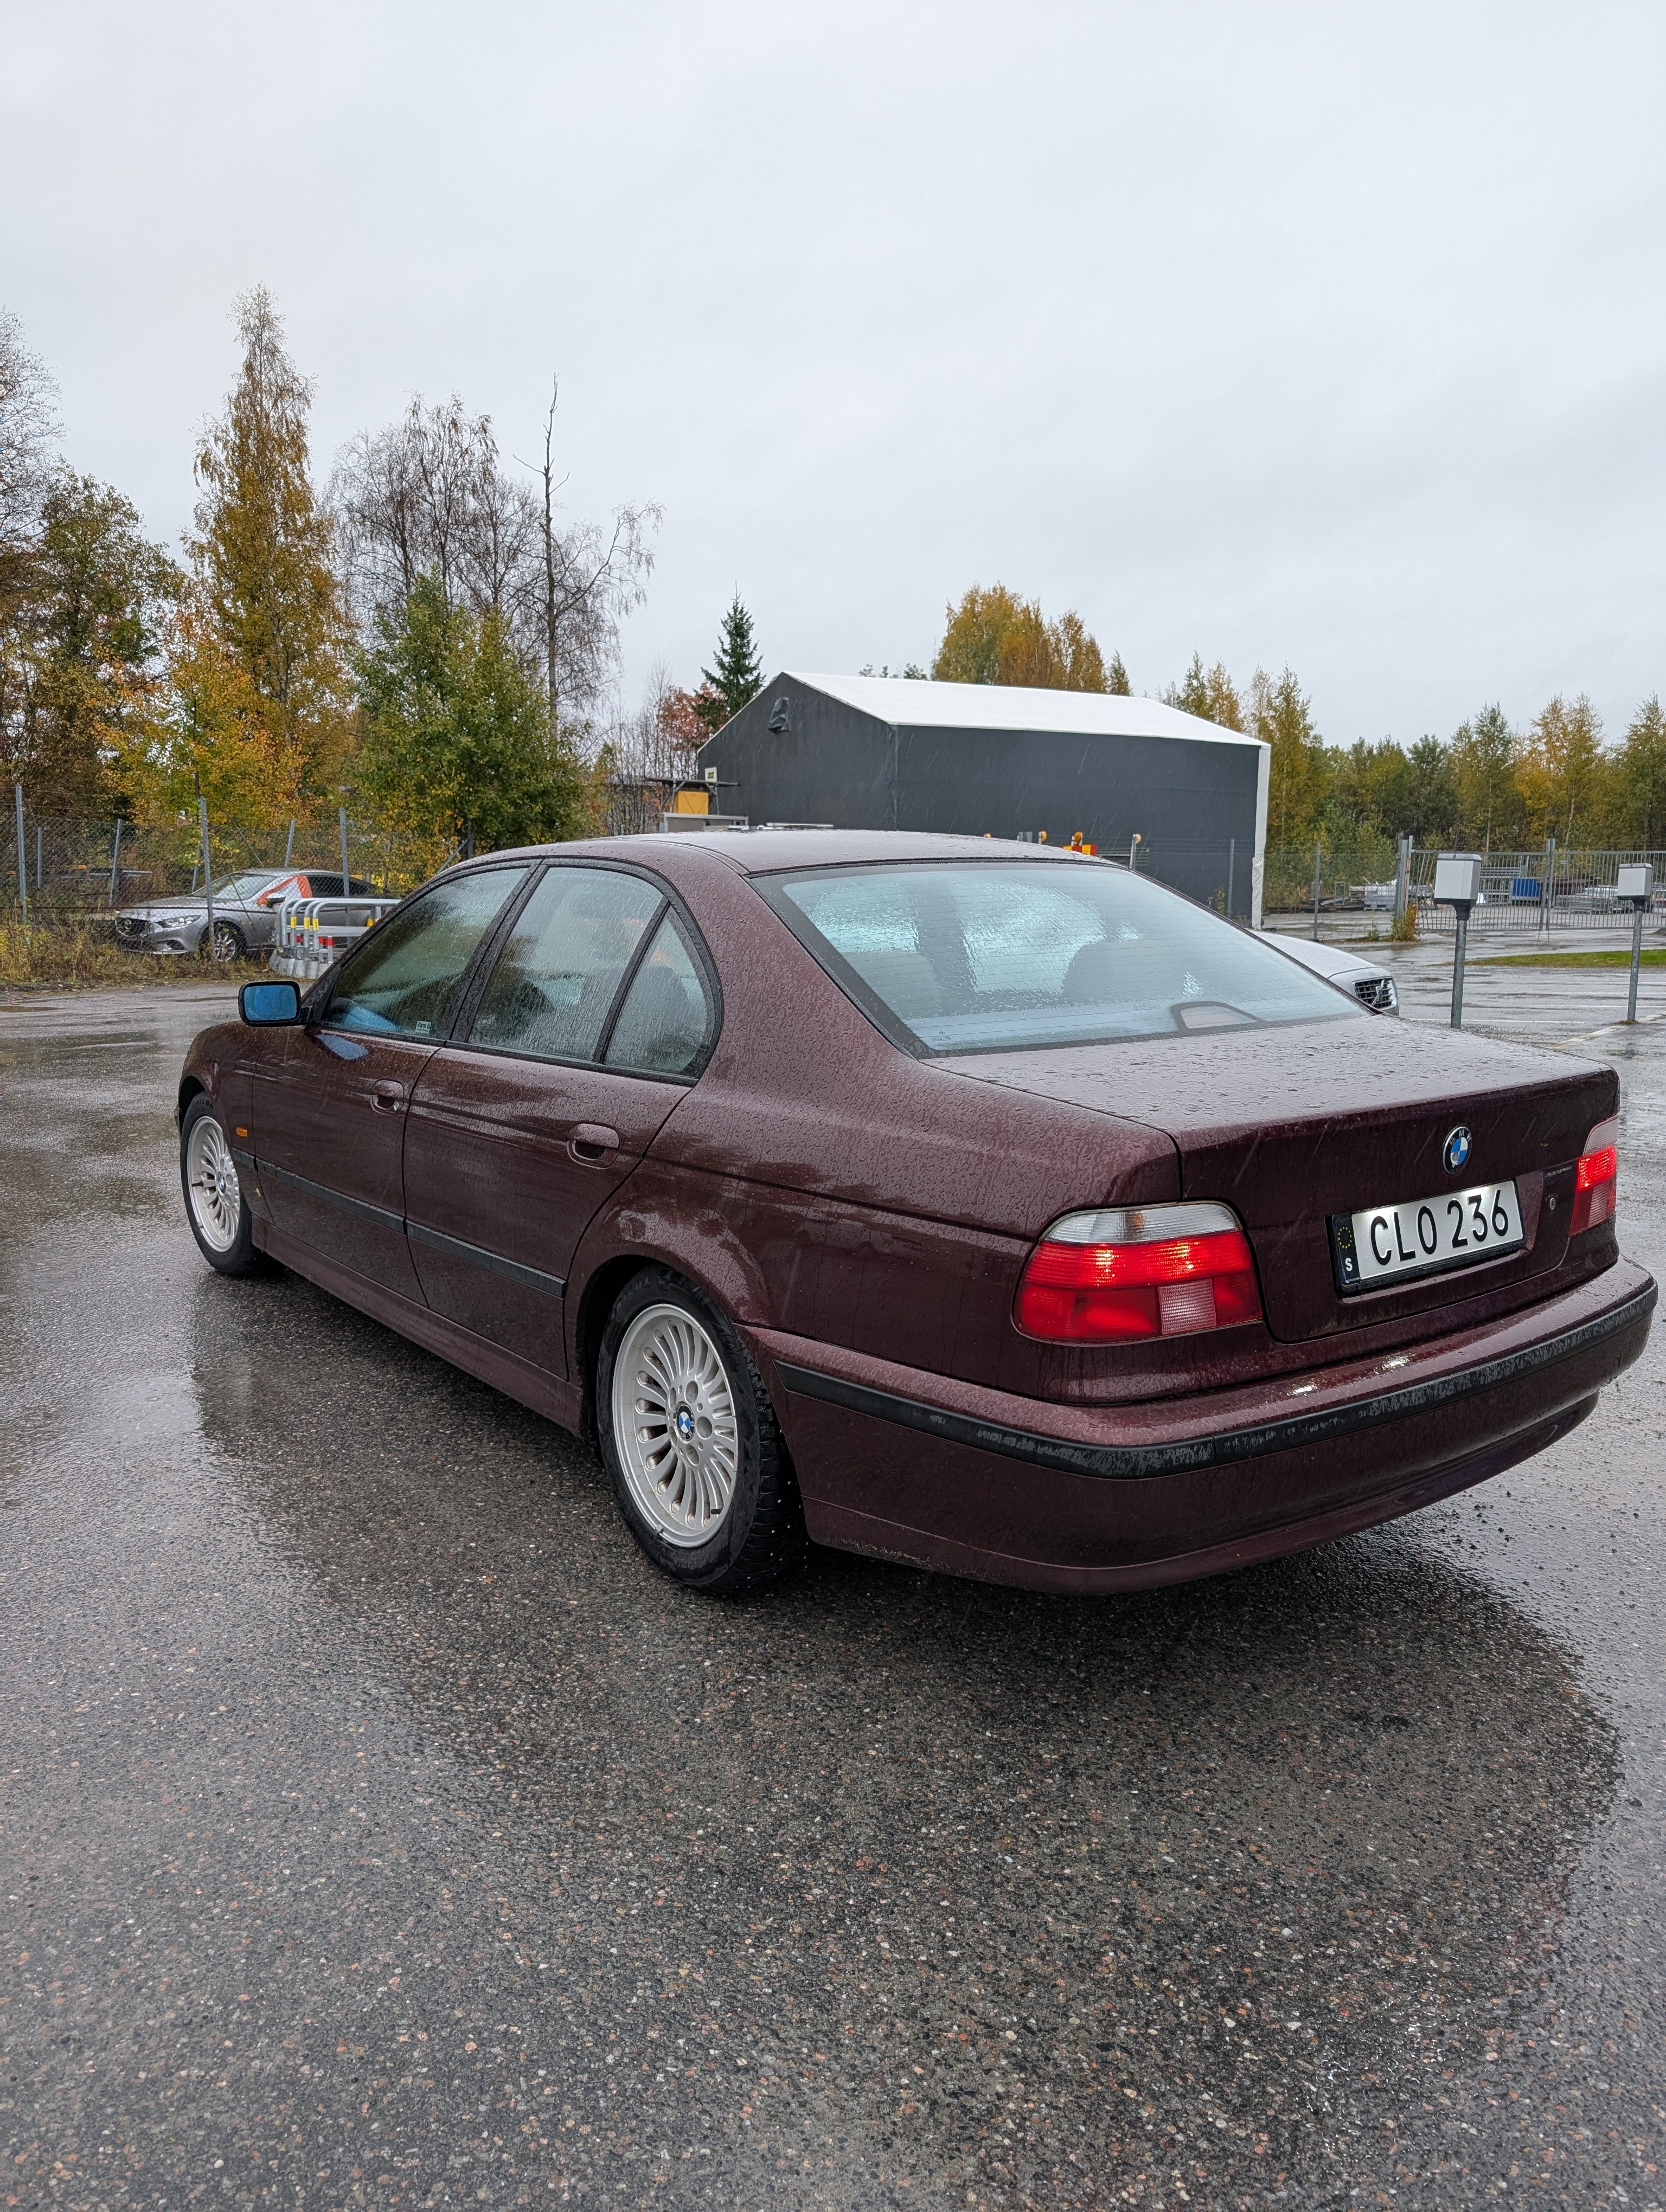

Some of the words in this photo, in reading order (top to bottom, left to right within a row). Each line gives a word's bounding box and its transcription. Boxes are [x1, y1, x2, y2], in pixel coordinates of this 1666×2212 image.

[1449, 1129, 1471, 1146] BMW
[1370, 1205, 1437, 1265] CLO
[1446, 1189, 1509, 1249] 236
[1345, 1257, 1353, 1271] S
